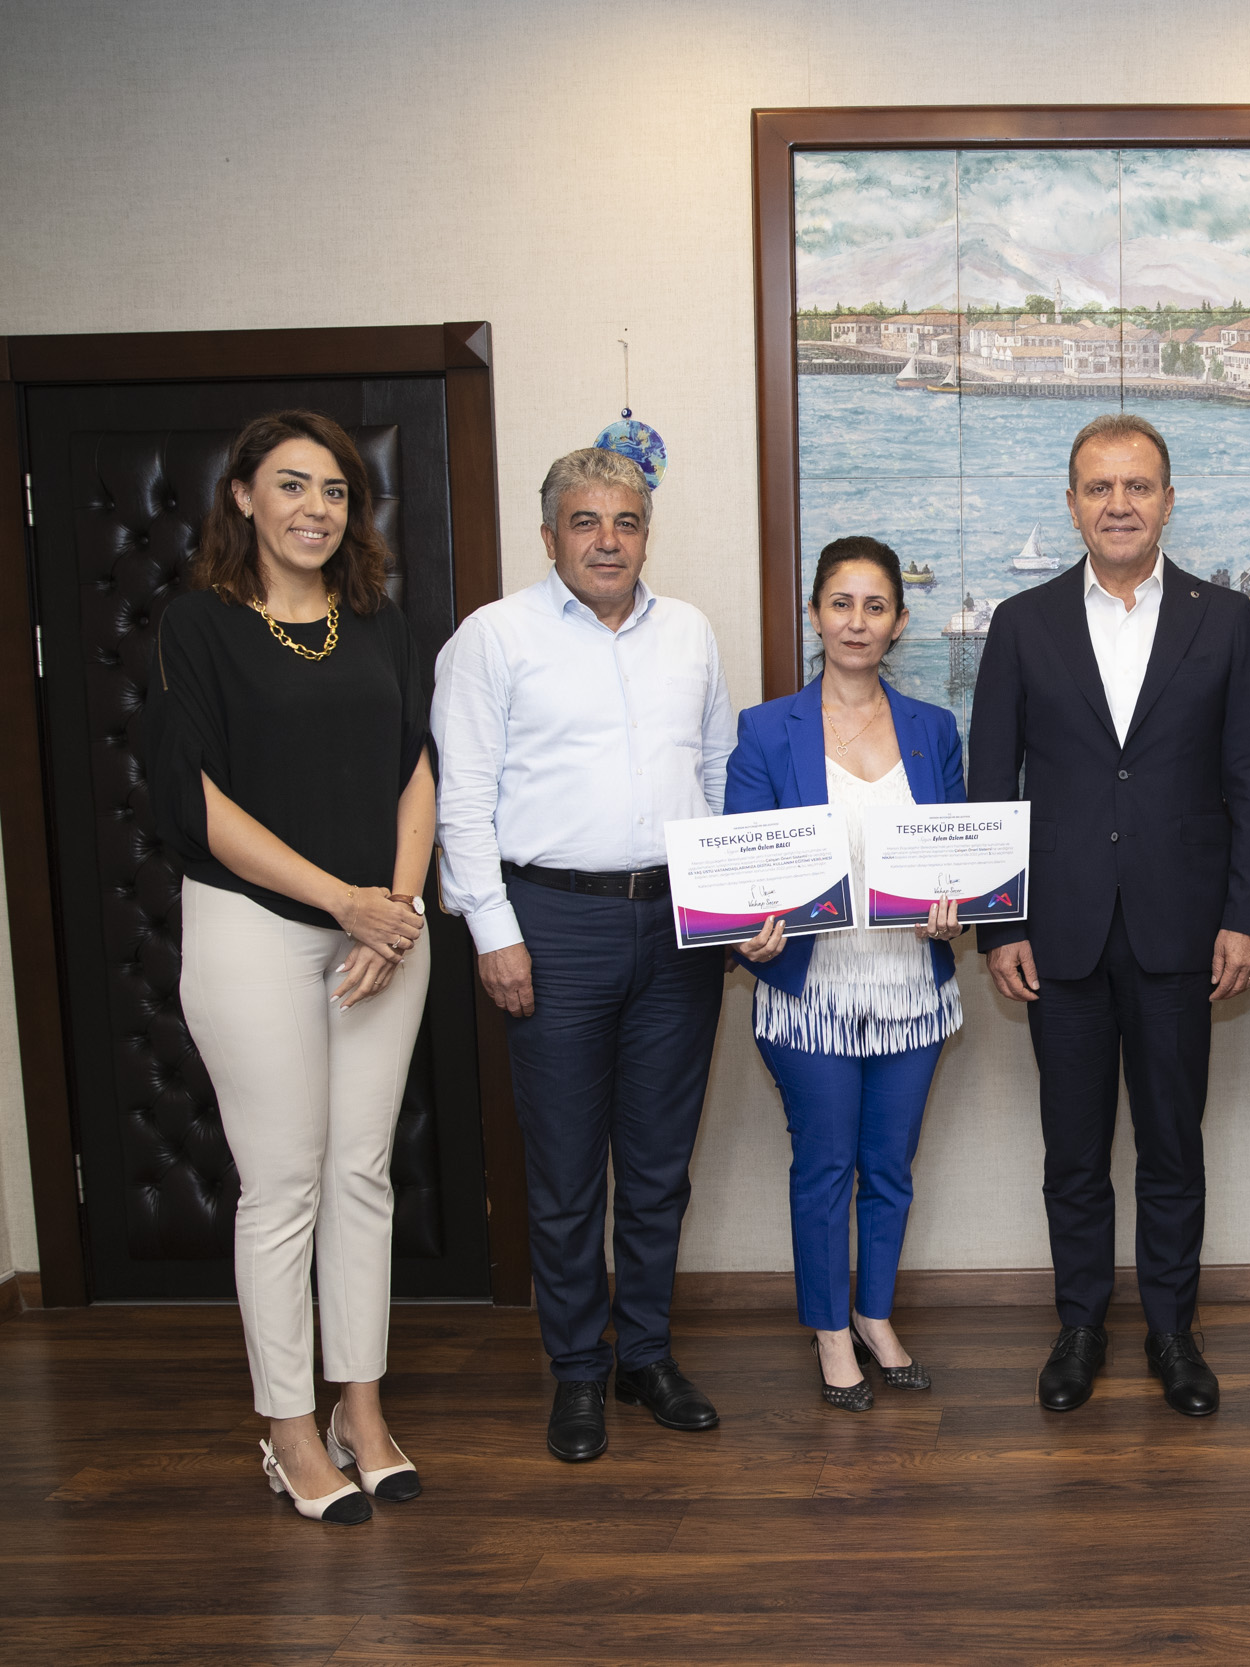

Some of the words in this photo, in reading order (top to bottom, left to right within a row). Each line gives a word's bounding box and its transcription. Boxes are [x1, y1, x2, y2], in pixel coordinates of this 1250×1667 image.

[698, 831, 763, 848] TEŞEKKÜR
[766, 824, 816, 840] BELGESİ
[896, 822, 955, 836] TEŞEKKÜR
[957, 819, 1002, 832] BELGESİ
[740, 844, 757, 854] Eylem
[775, 841, 791, 850] BALCI
